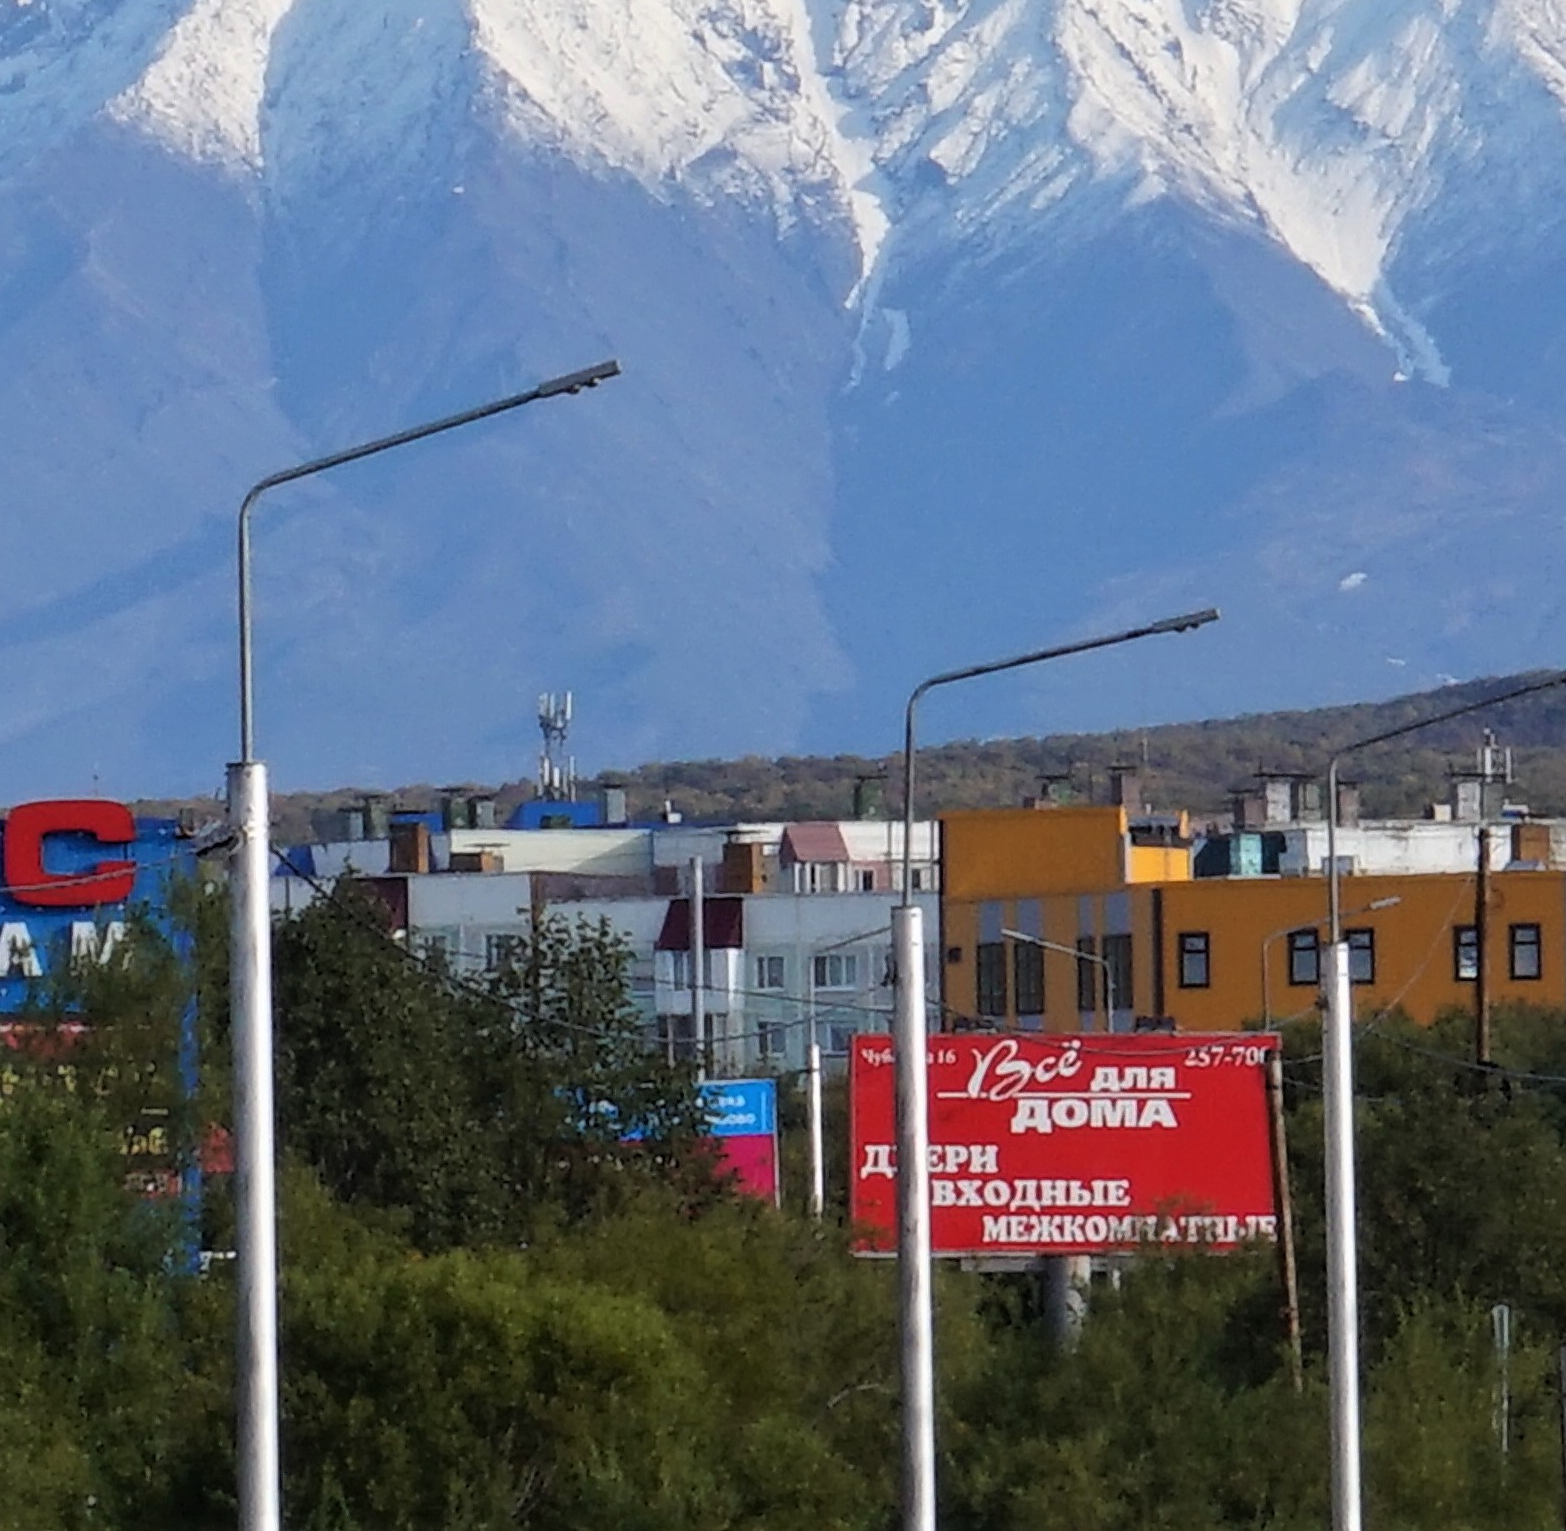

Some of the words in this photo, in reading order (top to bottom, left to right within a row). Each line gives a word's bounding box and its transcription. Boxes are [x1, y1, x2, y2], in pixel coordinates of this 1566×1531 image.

[966, 1039, 1084, 1102] Всё
[1010, 1099, 1178, 1134] ДОМА
[860, 1144, 999, 1179] ДЕРИ
[931, 1179, 1131, 1212] ВХОДНЫЕ
